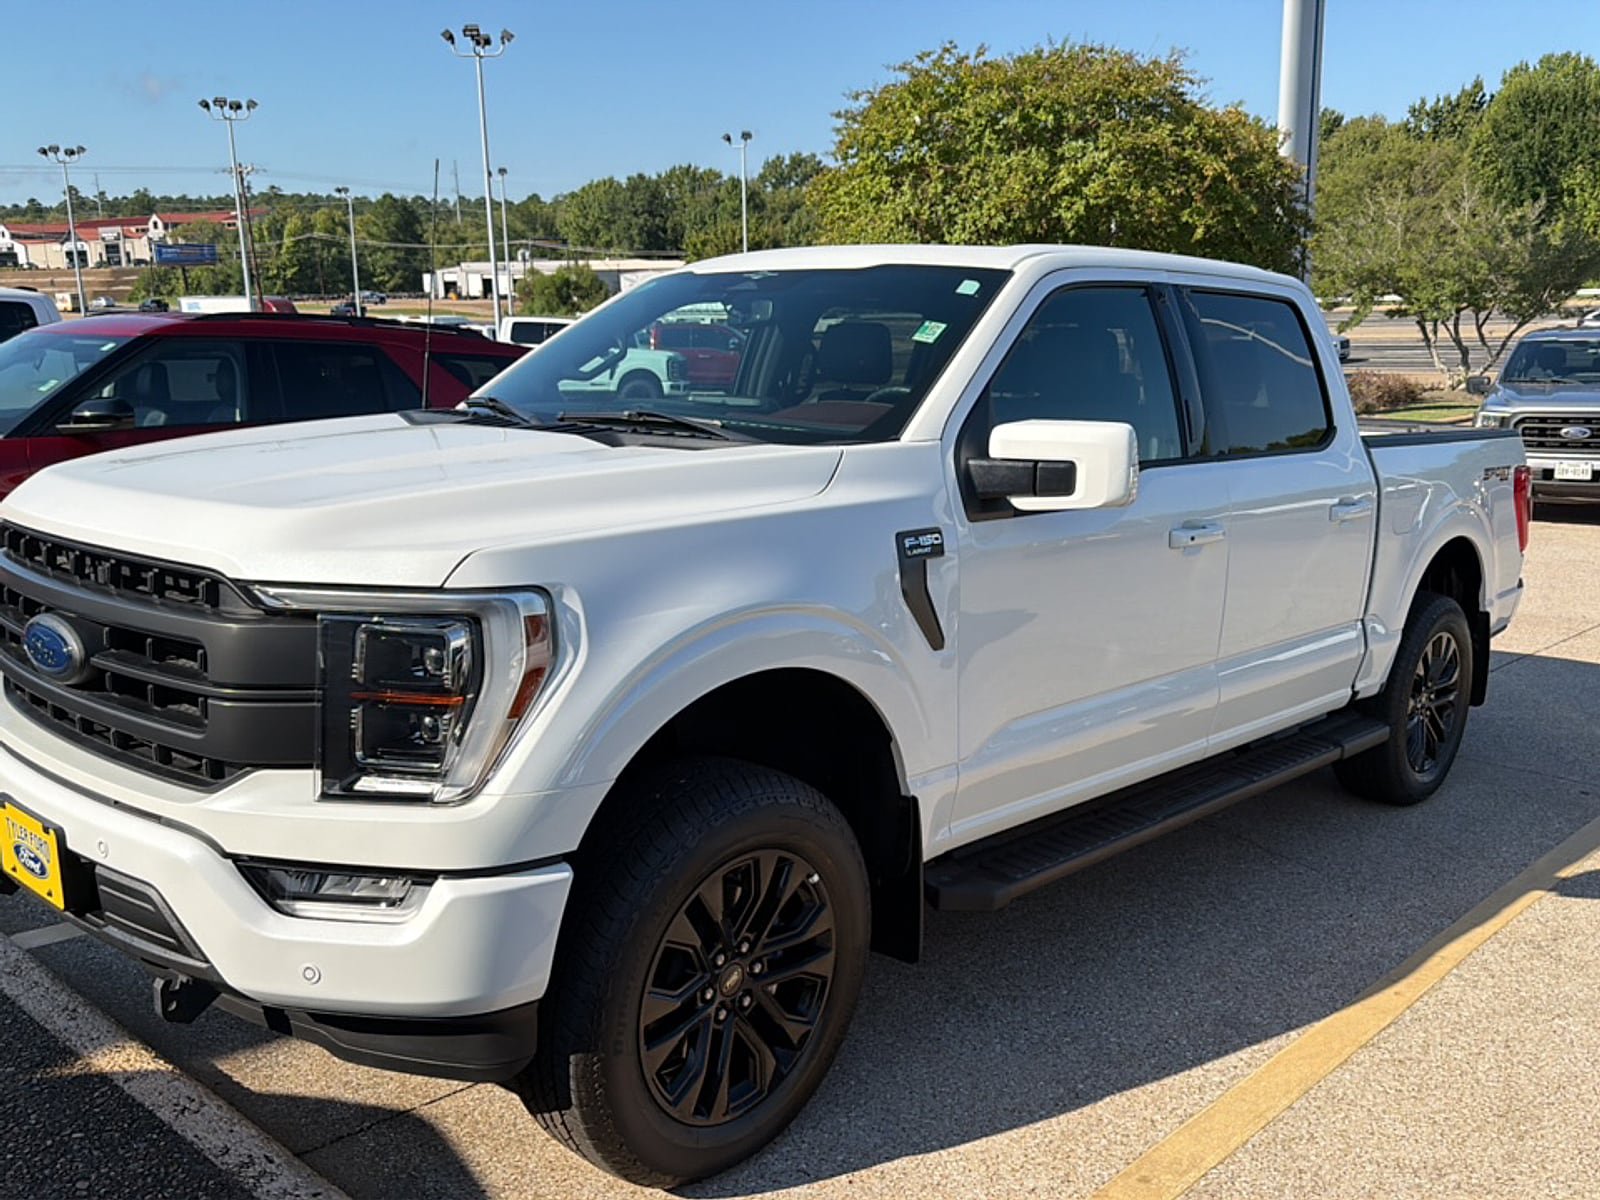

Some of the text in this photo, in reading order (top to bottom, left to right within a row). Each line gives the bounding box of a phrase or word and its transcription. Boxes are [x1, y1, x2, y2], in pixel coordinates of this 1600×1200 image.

[903, 533, 942, 548] F-150
[5, 816, 51, 864] TYLER FORD
[18, 844, 43, 876] Ford
